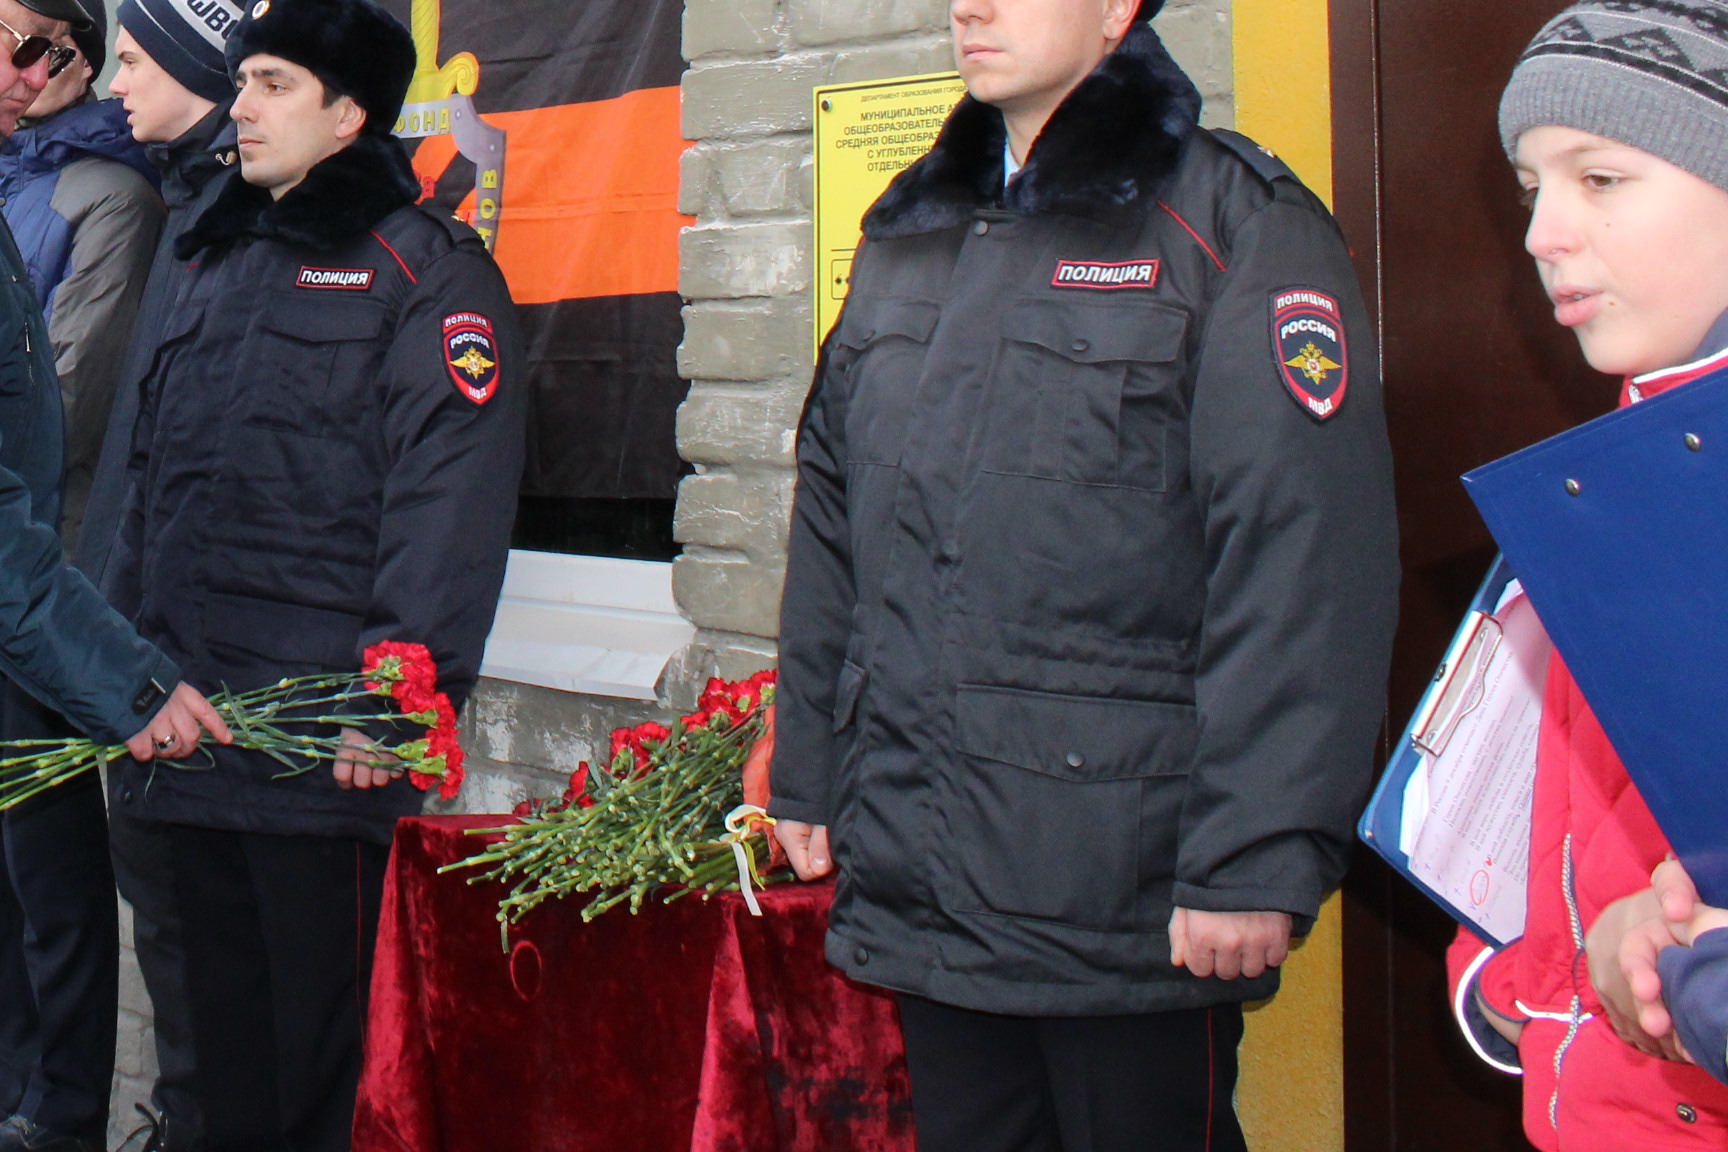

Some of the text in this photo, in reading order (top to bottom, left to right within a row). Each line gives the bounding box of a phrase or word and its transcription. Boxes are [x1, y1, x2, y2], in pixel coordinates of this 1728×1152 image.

[860, 91, 901, 103] ДЕПАРТАМЕНТ
[901, 88, 943, 98] ОБРАЗОВАНИЯ
[860, 104, 946, 122] МУНИЦИПАЛЬНОЕ
[843, 118, 945, 136] ОБЩЕОБРАЗОВАТЕЛЬ
[835, 131, 940, 149] СРЕДНЯЯ ОБЩЕОБРАЗ
[867, 144, 933, 159] С УГЛУБЛЕНН
[867, 160, 913, 173] ОТДЕЛЬН
[301, 269, 369, 286] ПОЛИЦИЯ
[1058, 264, 1152, 284] ПОЛИЦИЯ
[1276, 292, 1333, 312] ПОЛИЦИЯ
[445, 314, 488, 328] ПОЛИЦИЯ
[1280, 319, 1337, 343] РОССИЯ
[450, 332, 490, 349] РОССИЯ
[468, 386, 487, 399] МВД
[1307, 396, 1333, 415] МВД
